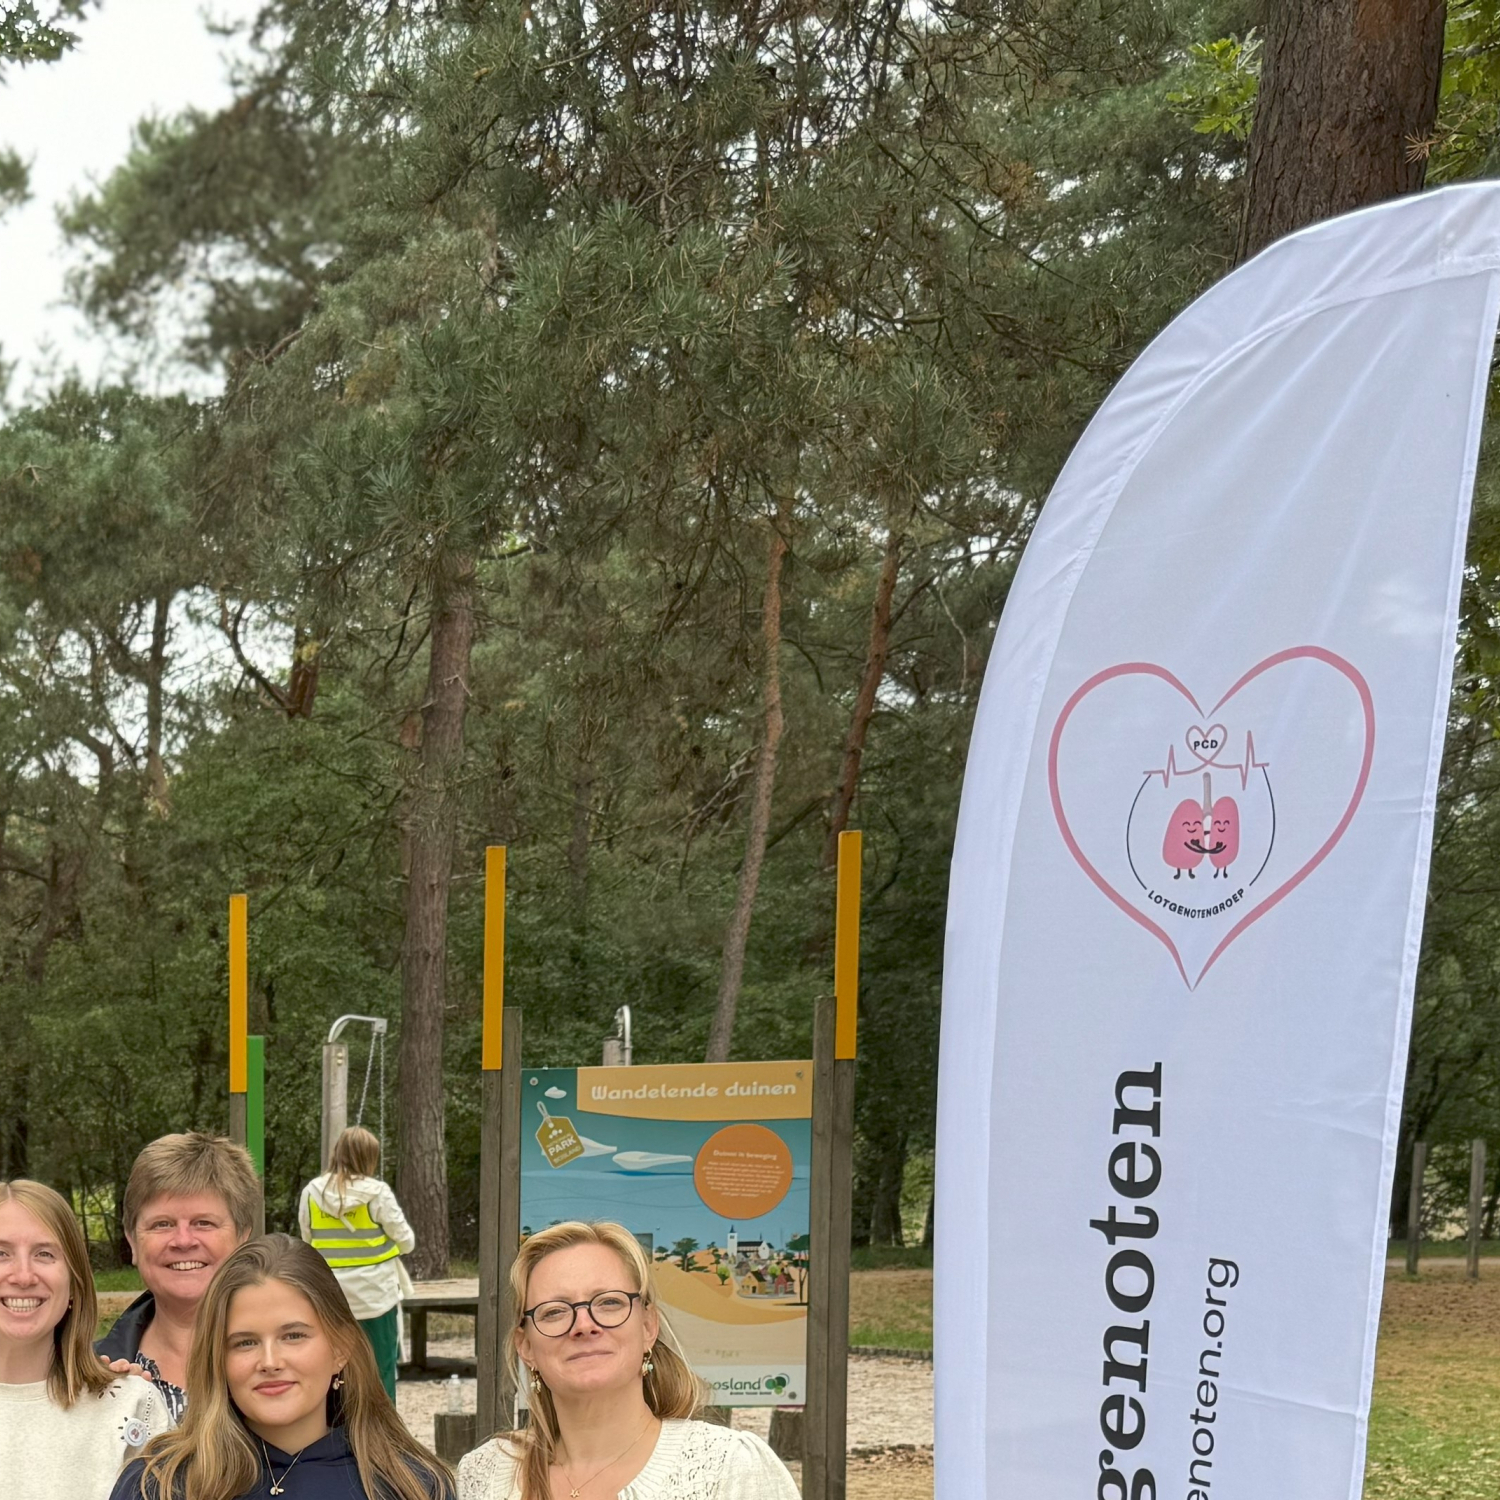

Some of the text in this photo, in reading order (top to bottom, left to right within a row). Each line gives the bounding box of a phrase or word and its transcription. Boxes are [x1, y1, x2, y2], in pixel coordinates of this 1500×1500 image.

[1193, 738, 1219, 751] PCD
[1147, 887, 1245, 919] LOTGENOTENGROEP
[591, 1081, 797, 1101] Wandelende duinen
[548, 1135, 577, 1156] PARK
